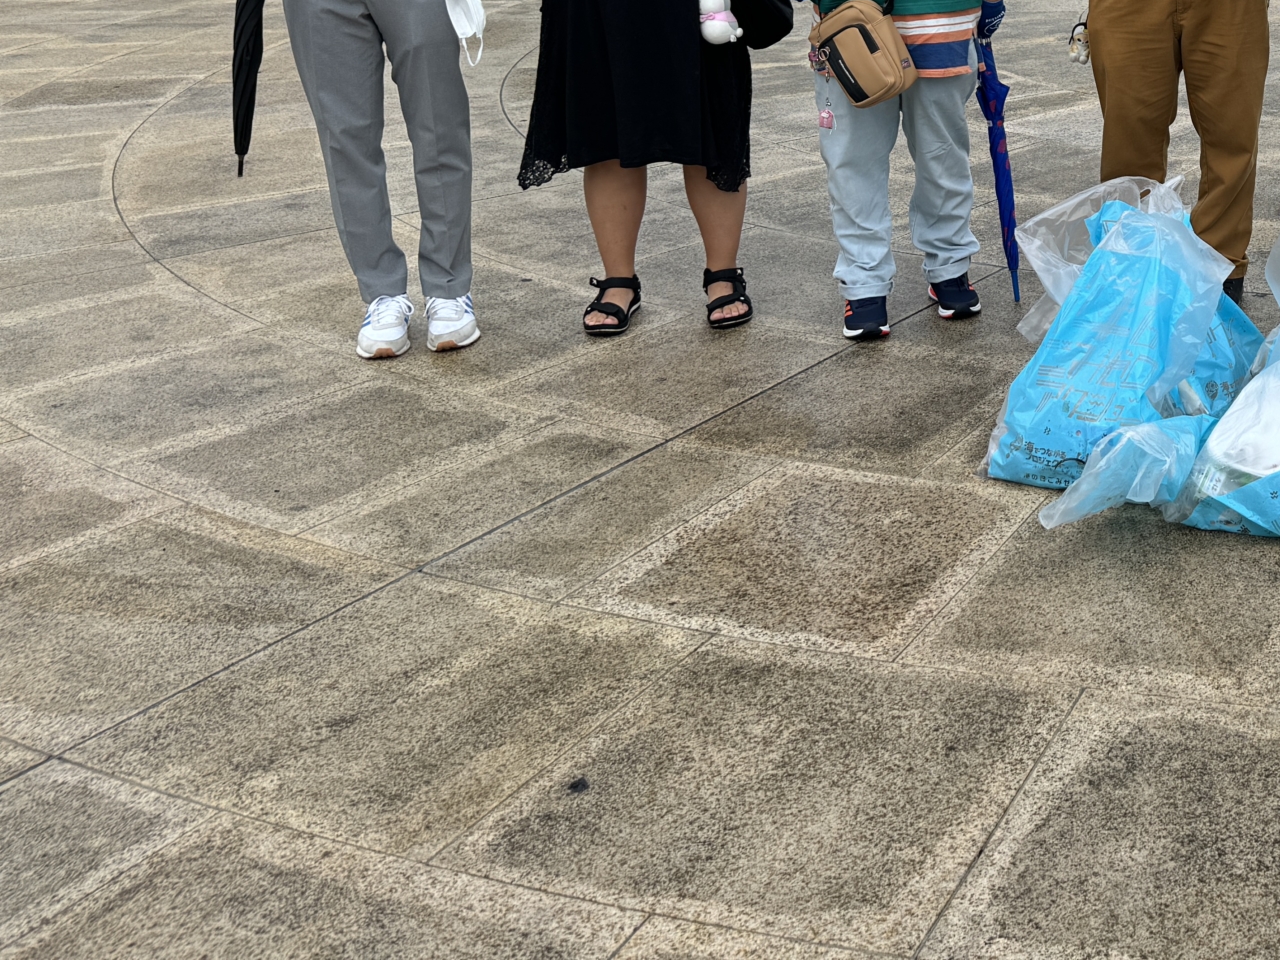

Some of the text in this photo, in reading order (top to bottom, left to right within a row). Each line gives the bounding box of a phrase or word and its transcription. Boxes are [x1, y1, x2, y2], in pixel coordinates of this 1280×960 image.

[1025, 454, 1060, 468] プロジェク
